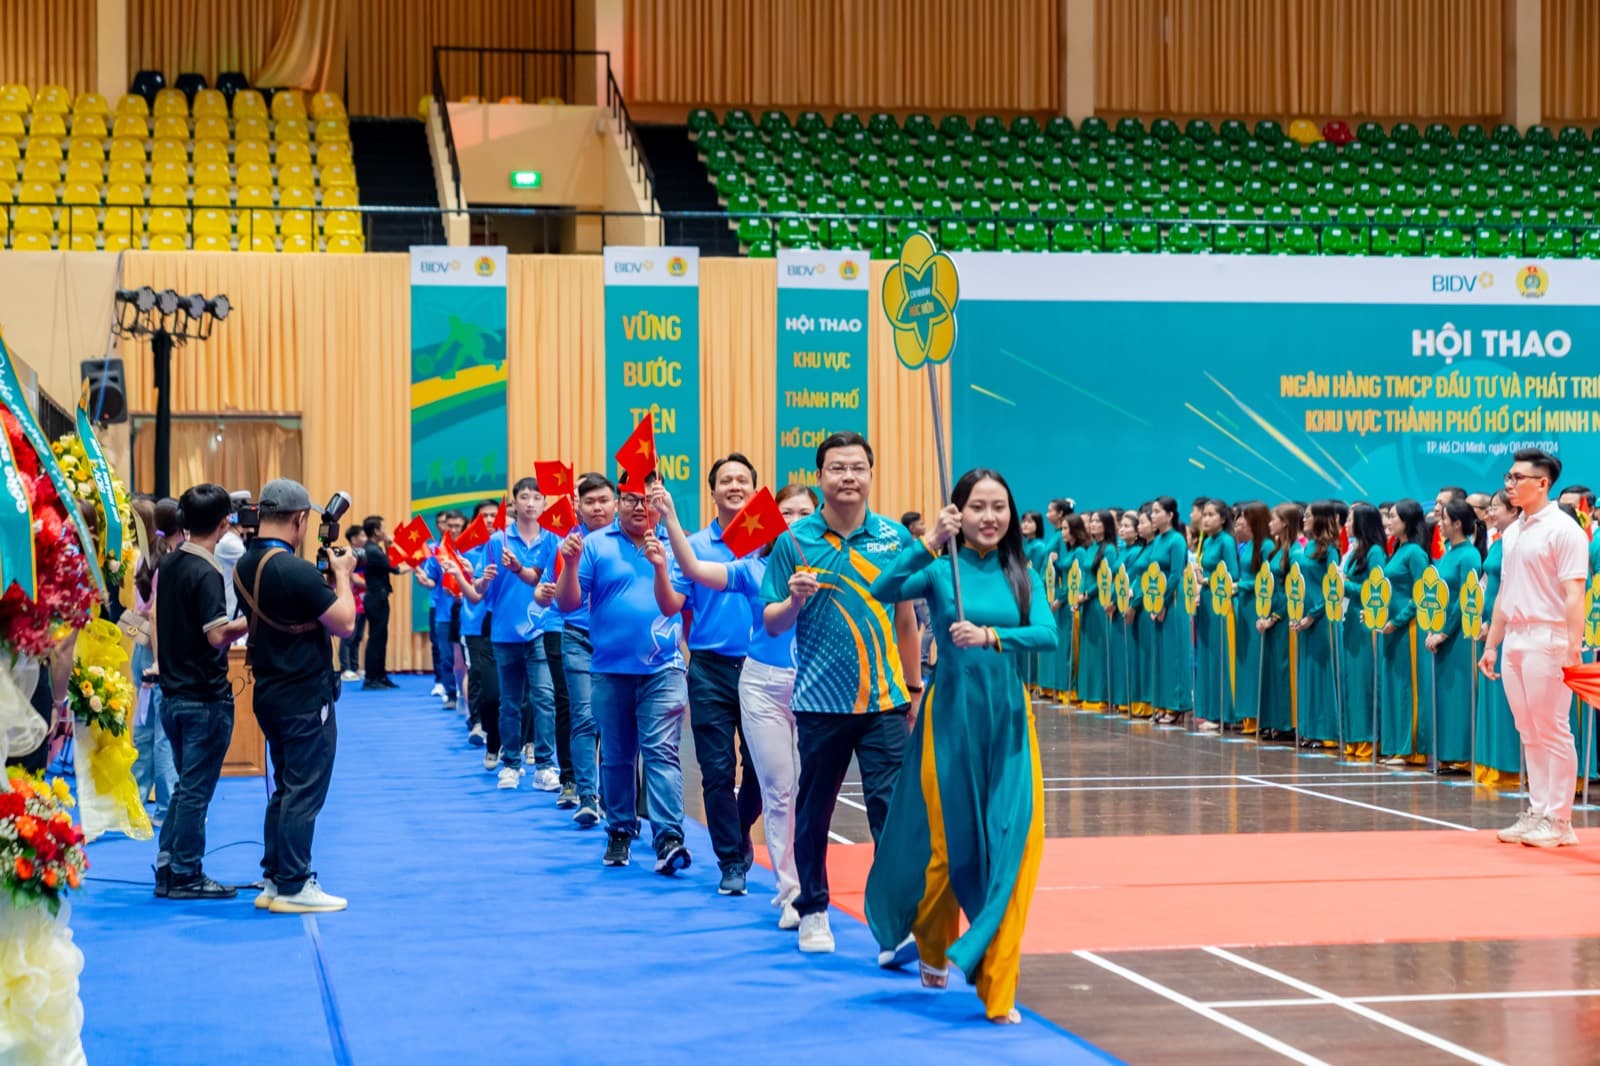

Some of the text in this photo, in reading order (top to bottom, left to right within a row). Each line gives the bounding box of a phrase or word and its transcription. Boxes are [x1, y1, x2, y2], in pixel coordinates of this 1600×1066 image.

[421, 262, 448, 273] BIDV
[614, 262, 641, 273] BIDV
[787, 265, 815, 276] BIDV
[1432, 275, 1477, 292] BIDV
[622, 310, 682, 341] VỮNG
[785, 314, 863, 335] HỘI THAO
[1412, 321, 1572, 365] HỘI THAO
[623, 356, 682, 387] BƯỚC
[793, 351, 851, 373] KHU VỰC
[1280, 370, 1330, 398] NGÂN
[1332, 370, 1381, 398] HÀNG
[1384, 375, 1432, 398] TMCP
[1474, 375, 1498, 398] TƯ
[1501, 371, 1522, 398] VÀ
[1525, 371, 1568, 398] PHÁT
[784, 387, 860, 409] THÀNH PHỐ
[1305, 409, 1343, 432] KHU
[1345, 408, 1382, 437] VỰC
[1384, 405, 1442, 432] THÀNH
[1446, 404, 1482, 432] PHỐ
[1512, 405, 1542, 432] CHÍ
[1545, 410, 1589, 432] MINH
